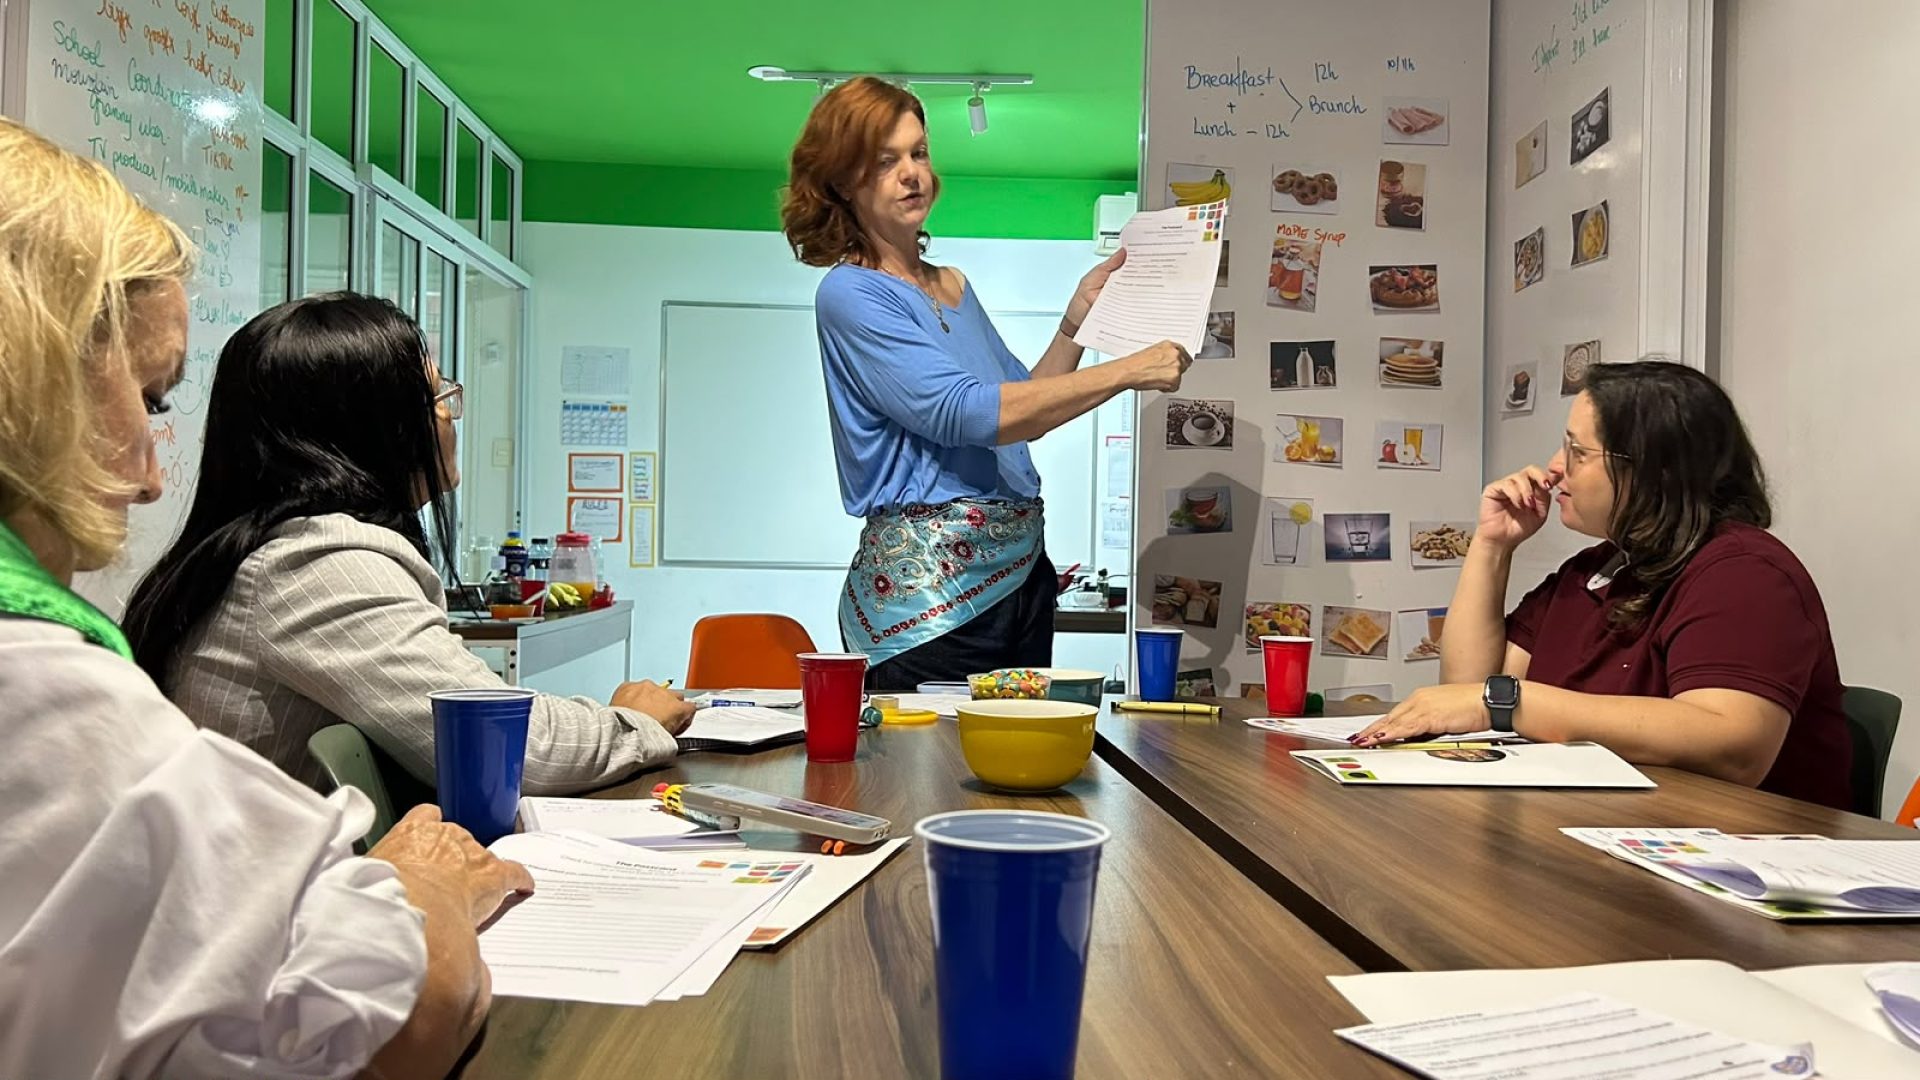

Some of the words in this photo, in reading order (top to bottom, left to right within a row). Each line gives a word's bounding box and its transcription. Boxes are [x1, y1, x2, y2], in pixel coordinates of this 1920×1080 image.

[1315, 63, 1339, 83] 12h
[1309, 95, 1367, 114] Brunch
[1194, 118, 1237, 137] Lunch
[1265, 124, 1290, 139] 12h
